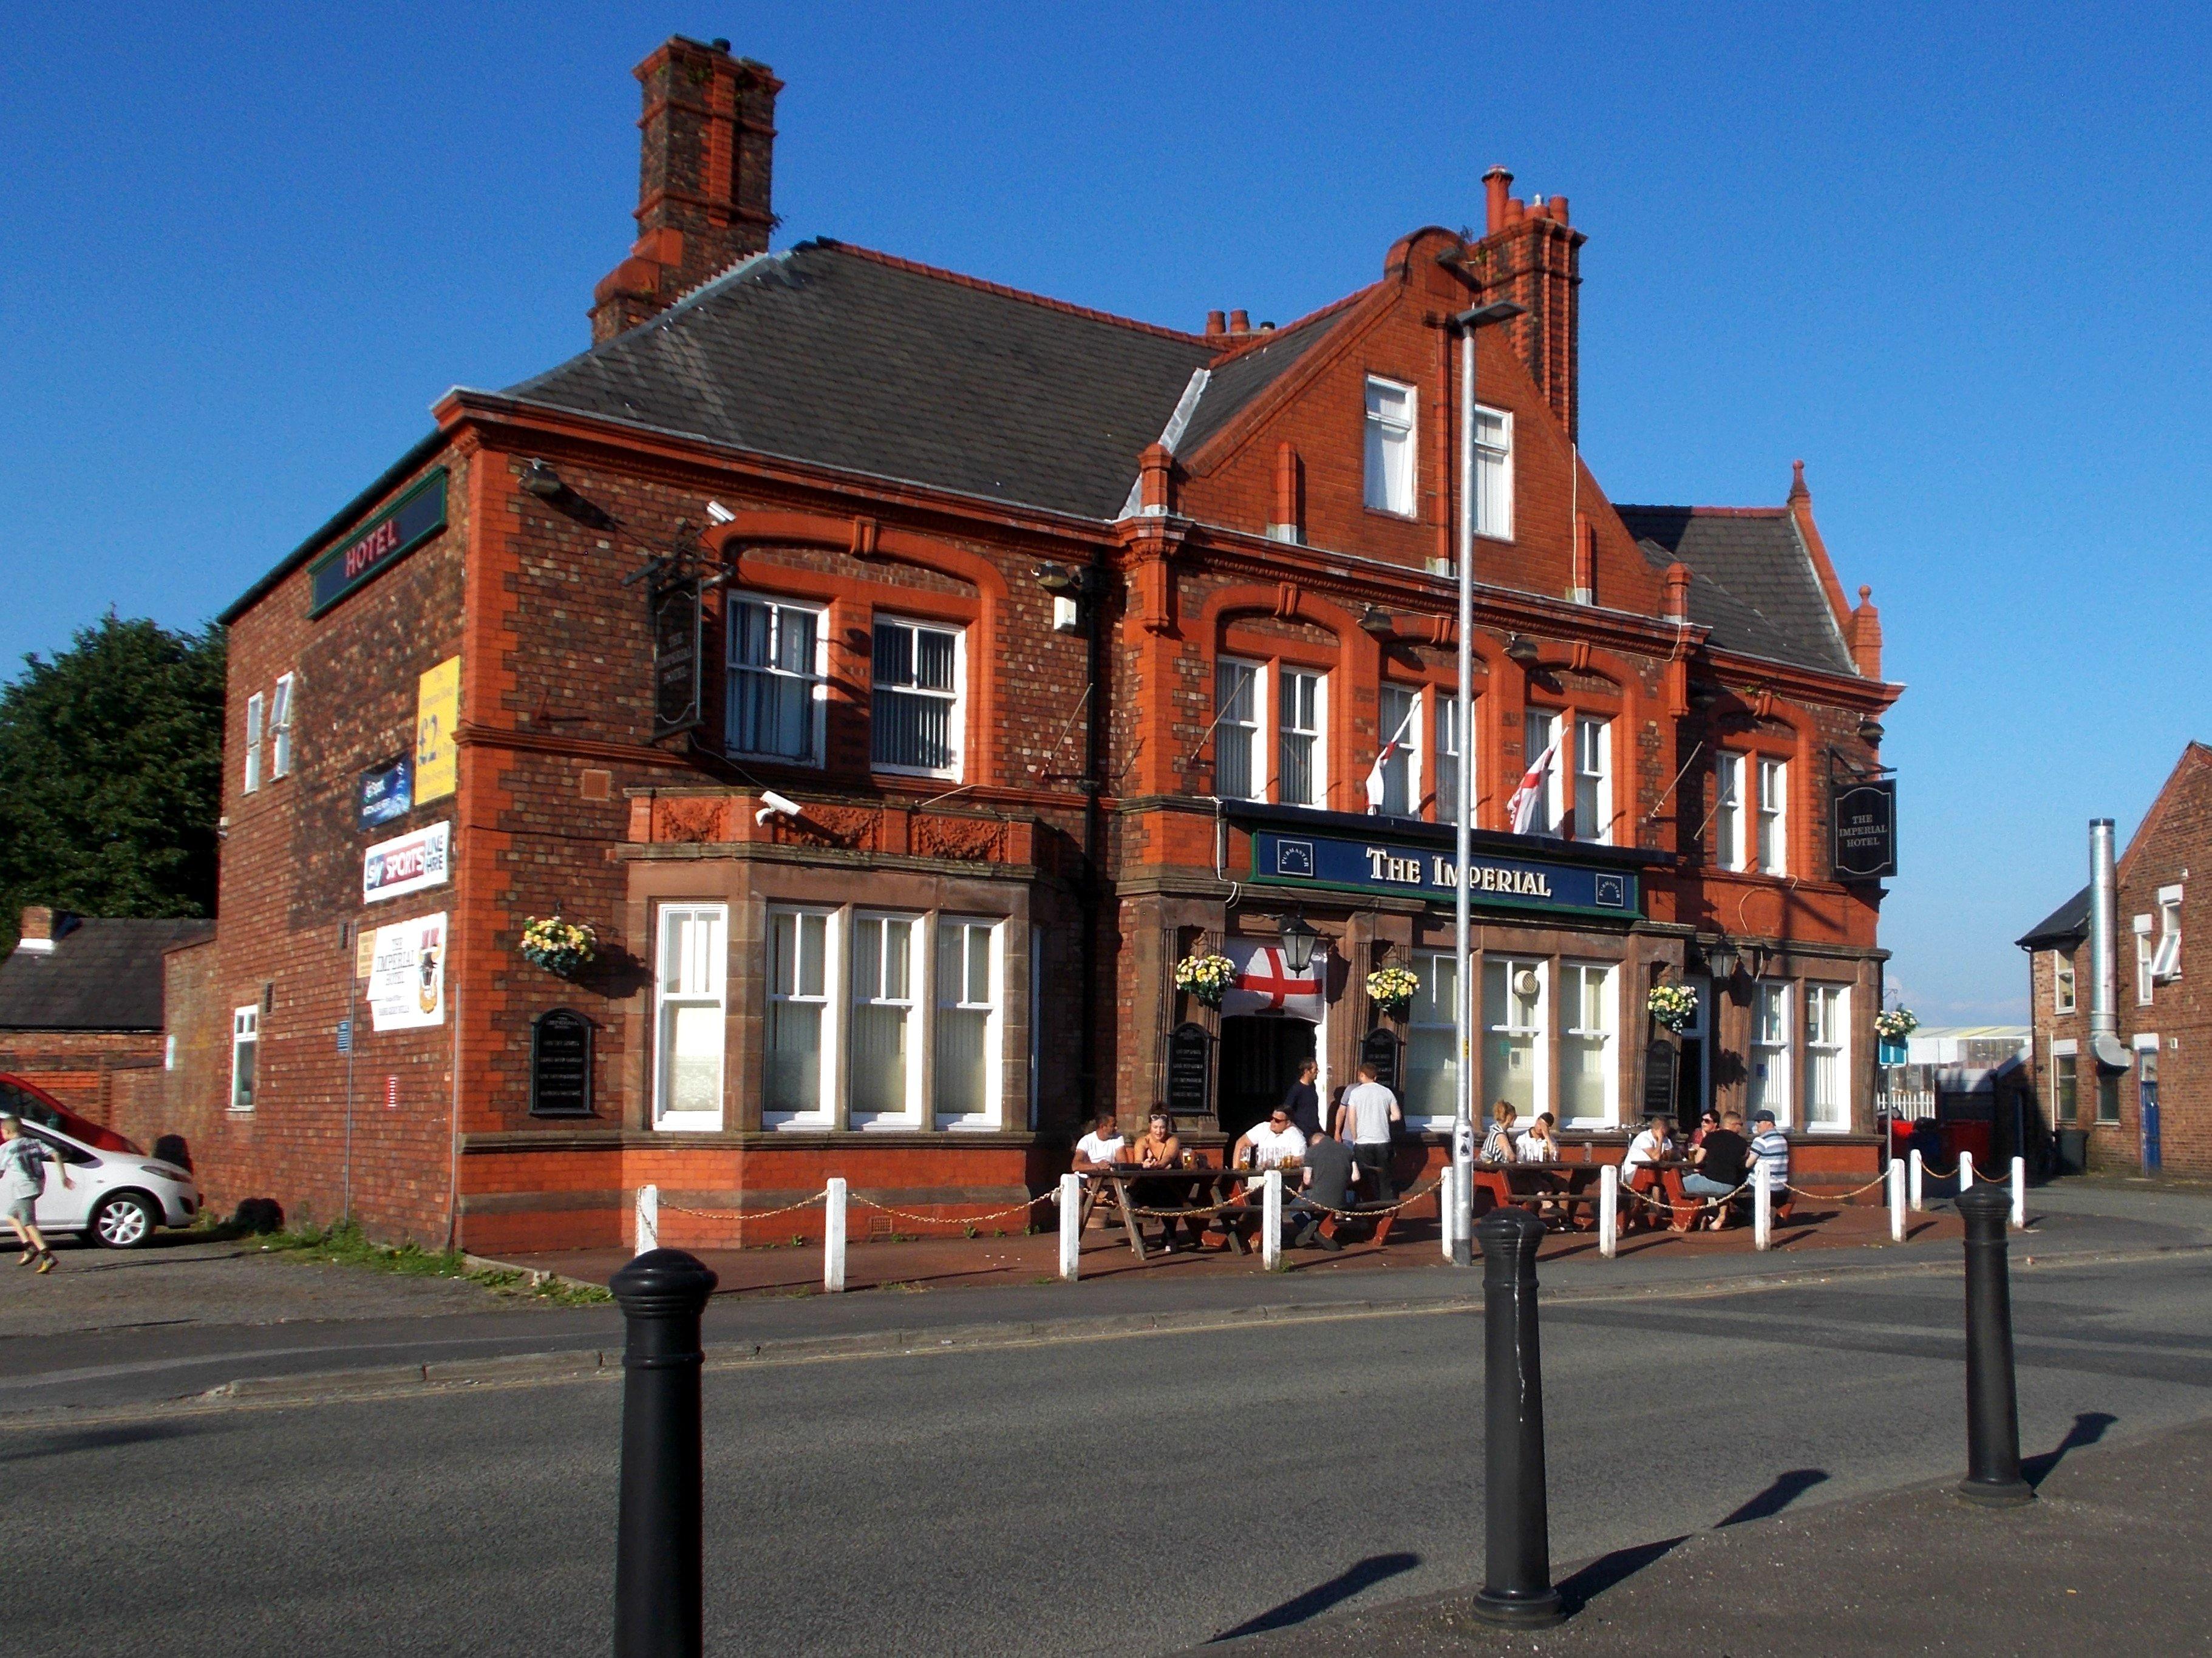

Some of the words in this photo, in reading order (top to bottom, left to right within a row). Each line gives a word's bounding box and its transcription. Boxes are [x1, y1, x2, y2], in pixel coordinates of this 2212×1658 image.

[345, 519, 399, 578] HOTEL
[1852, 814, 1873, 824] THE
[1839, 824, 1887, 837] IMPERIAL
[1846, 837, 1880, 848] HOTEL
[386, 846, 424, 880] SPORTS
[1281, 848, 1309, 868] PUBMASTER
[1366, 847, 1421, 884] THE
[1599, 881, 1620, 899] PUBMASTER
[376, 950, 415, 973] IMPERIAL
